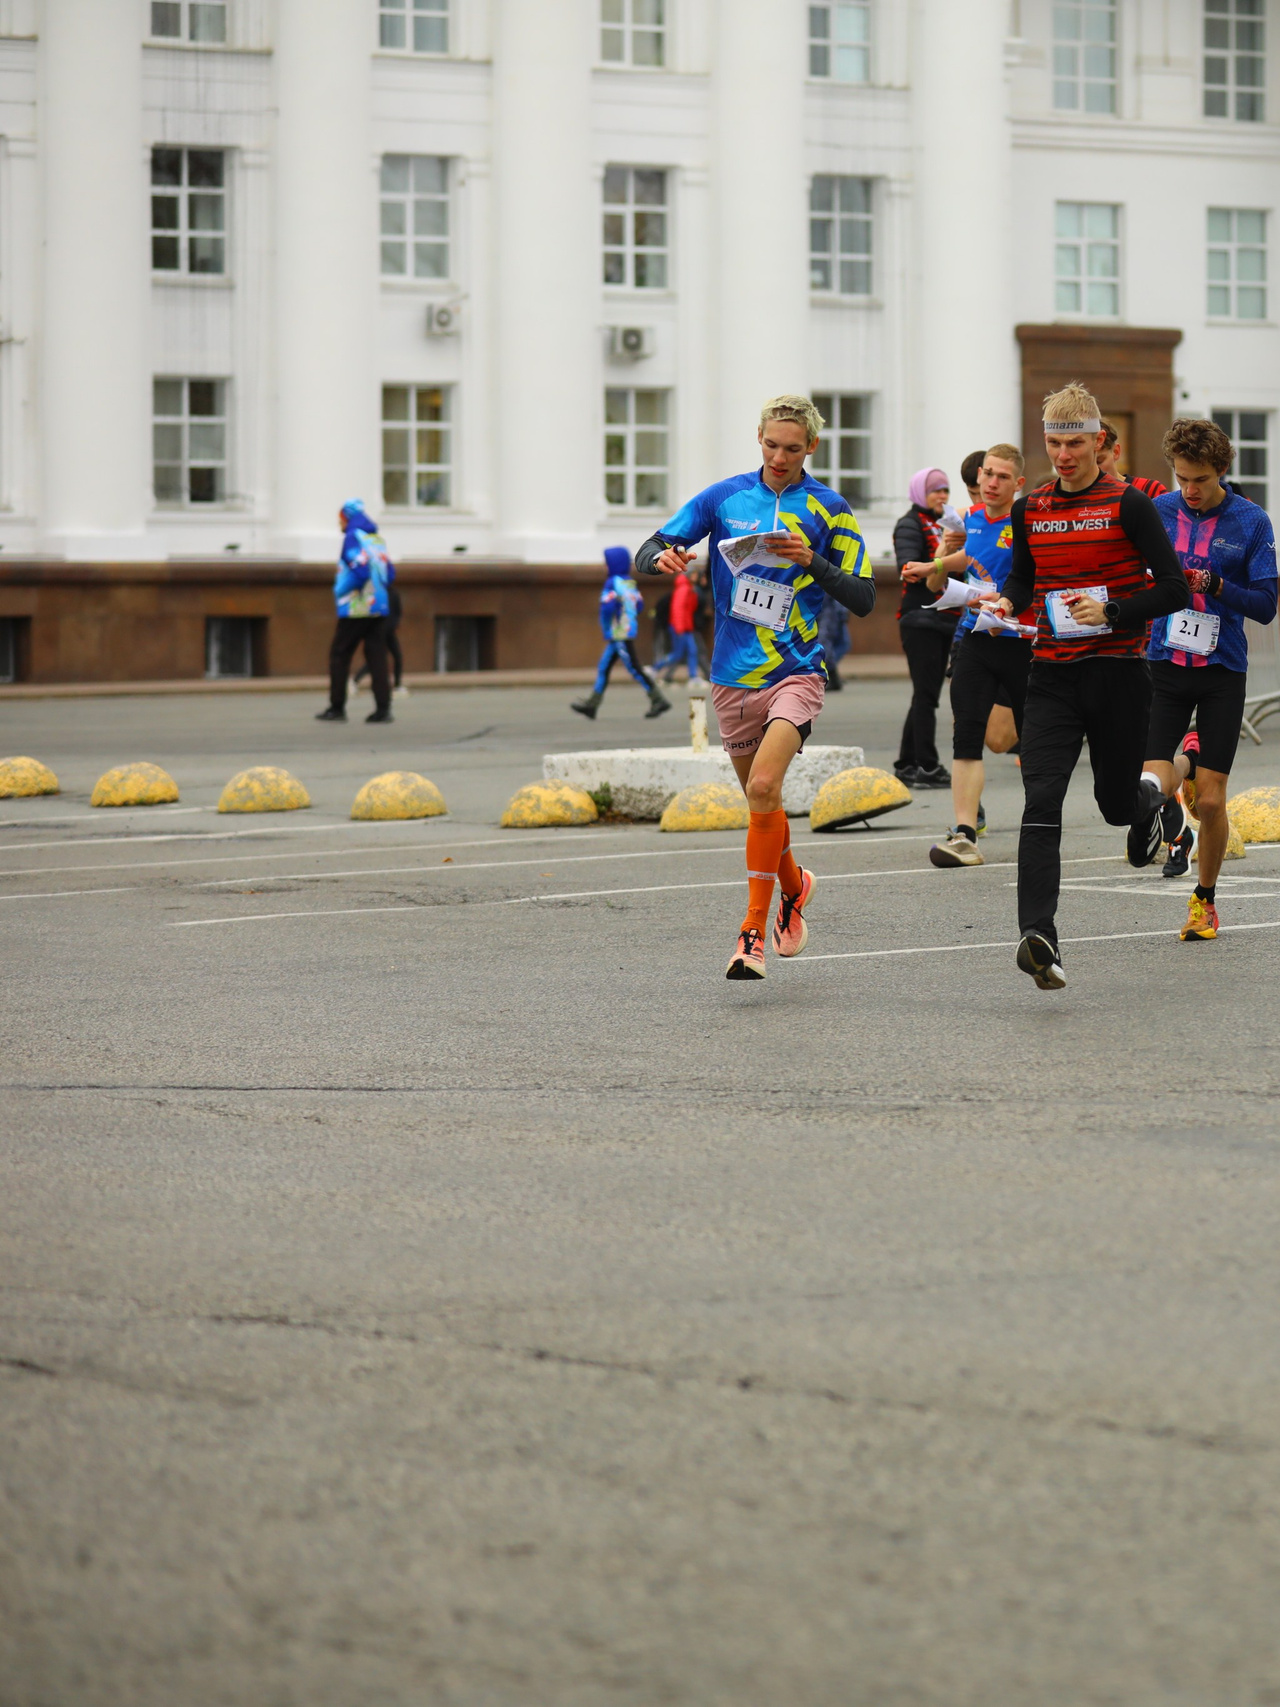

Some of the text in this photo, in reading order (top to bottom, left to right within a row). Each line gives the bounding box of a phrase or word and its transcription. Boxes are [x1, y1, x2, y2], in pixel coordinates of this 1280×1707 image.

[1032, 517, 1112, 533] NORD WEST
[742, 588, 774, 610] 11.1
[1179, 620, 1200, 637] 2.1
